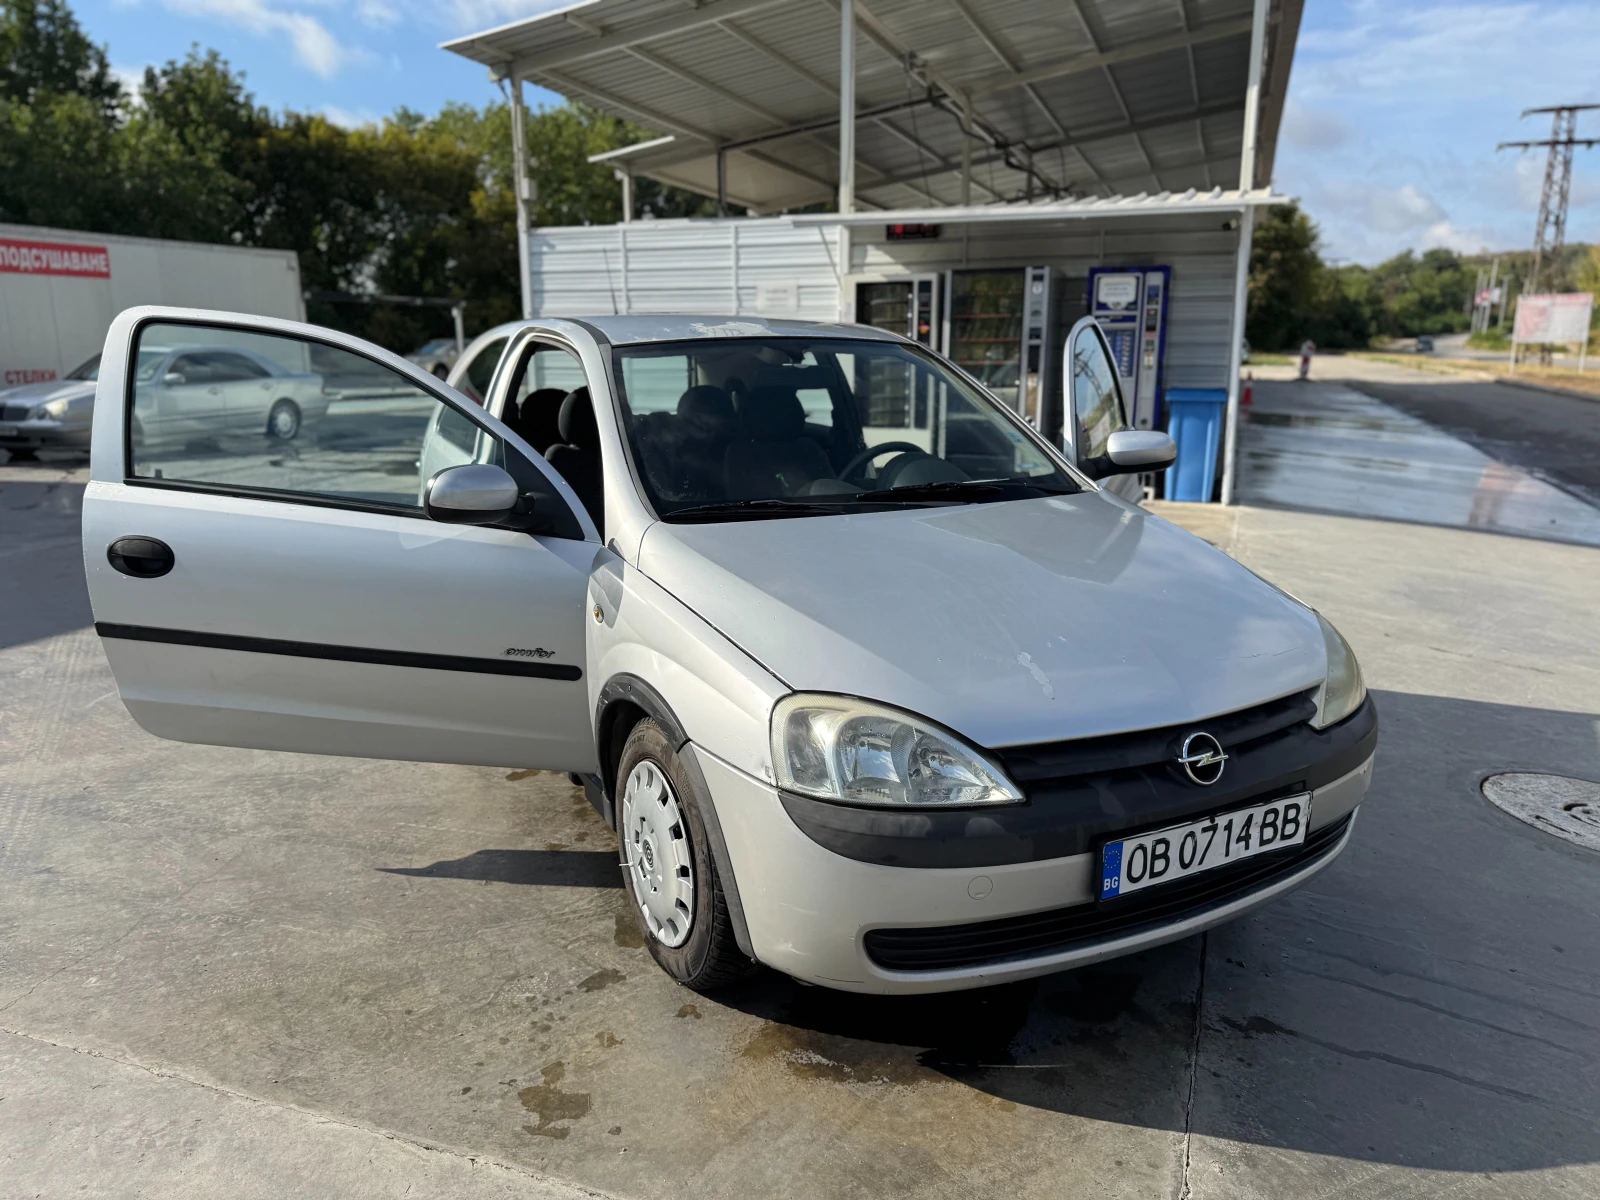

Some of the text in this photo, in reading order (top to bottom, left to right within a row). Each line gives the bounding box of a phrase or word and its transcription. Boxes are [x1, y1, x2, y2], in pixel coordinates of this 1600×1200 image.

[1126, 802, 1301, 884] OB 0714 BB
[1103, 876, 1119, 891] BG
